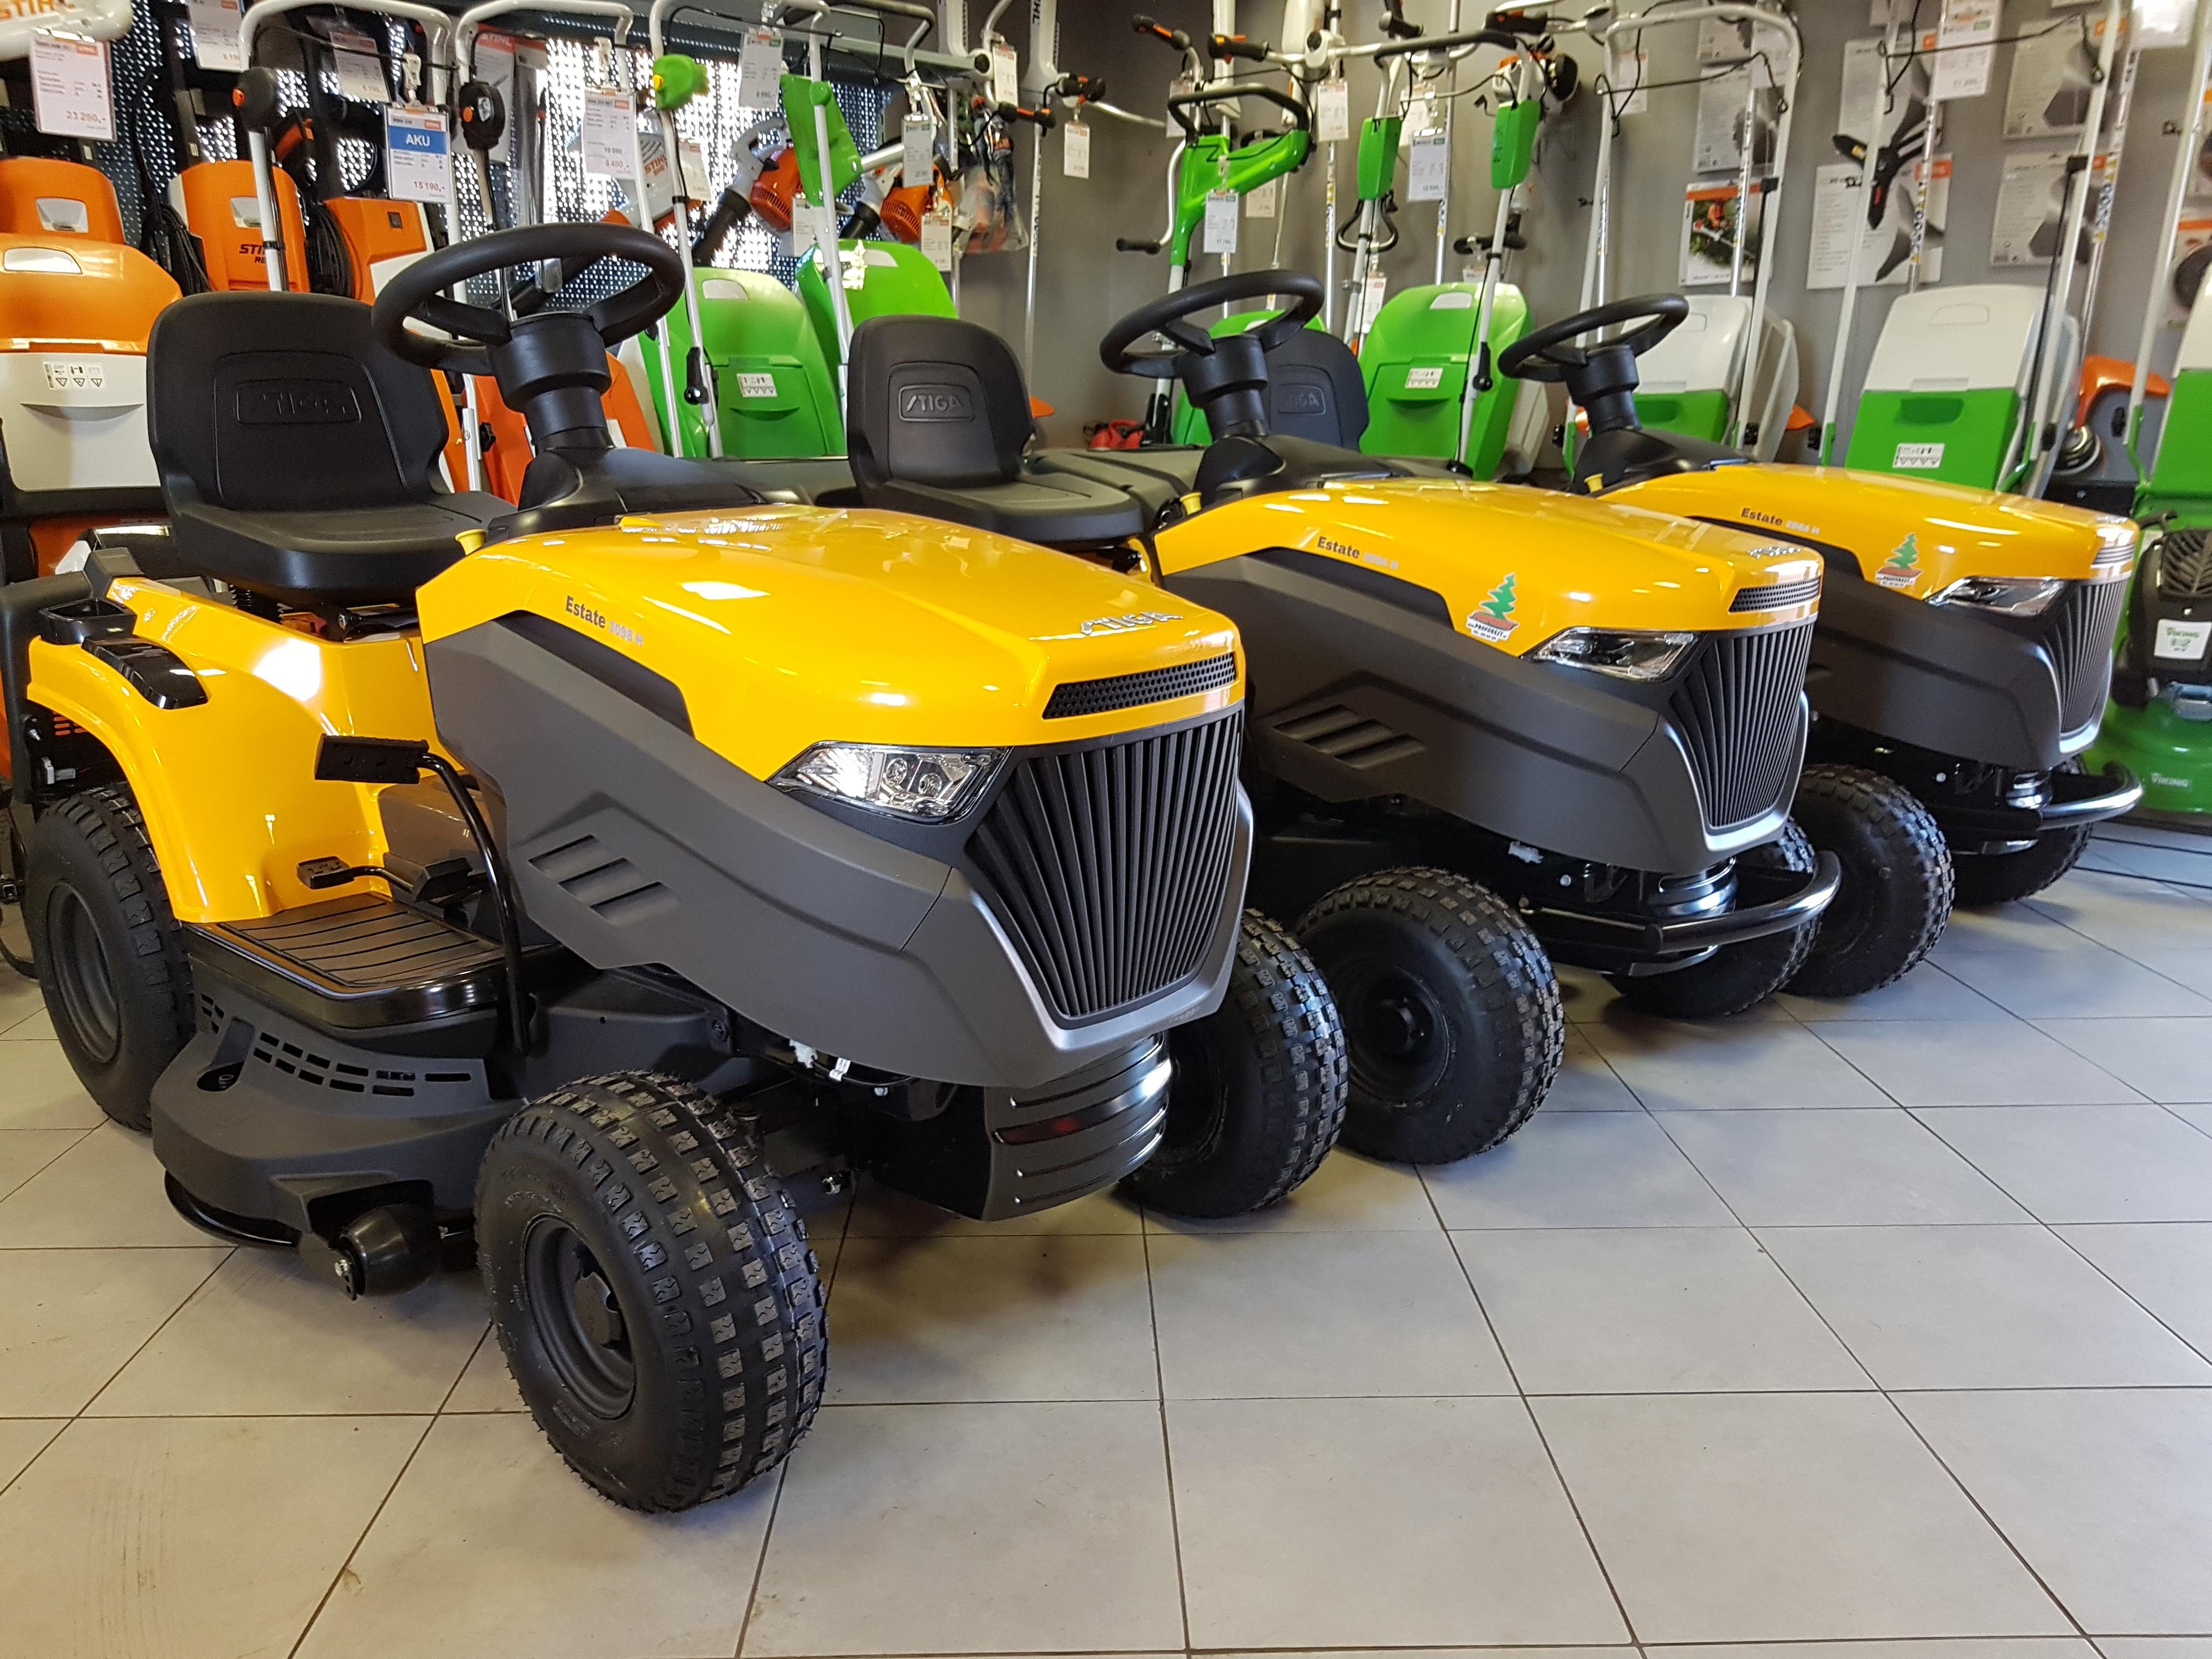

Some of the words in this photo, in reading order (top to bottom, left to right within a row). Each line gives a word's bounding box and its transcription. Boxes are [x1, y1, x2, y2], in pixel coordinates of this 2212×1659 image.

[405, 133, 431, 147] AKU
[414, 181, 424, 190] 15
[425, 181, 445, 192] 190,-
[238, 243, 265, 255] STI
[906, 394, 964, 411] STIGA
[1741, 507, 1783, 526] Estate
[1317, 535, 1360, 559] Estate
[565, 594, 606, 629] Estate
[635, 632, 643, 647] H
[1081, 611, 1184, 635] STIGA
